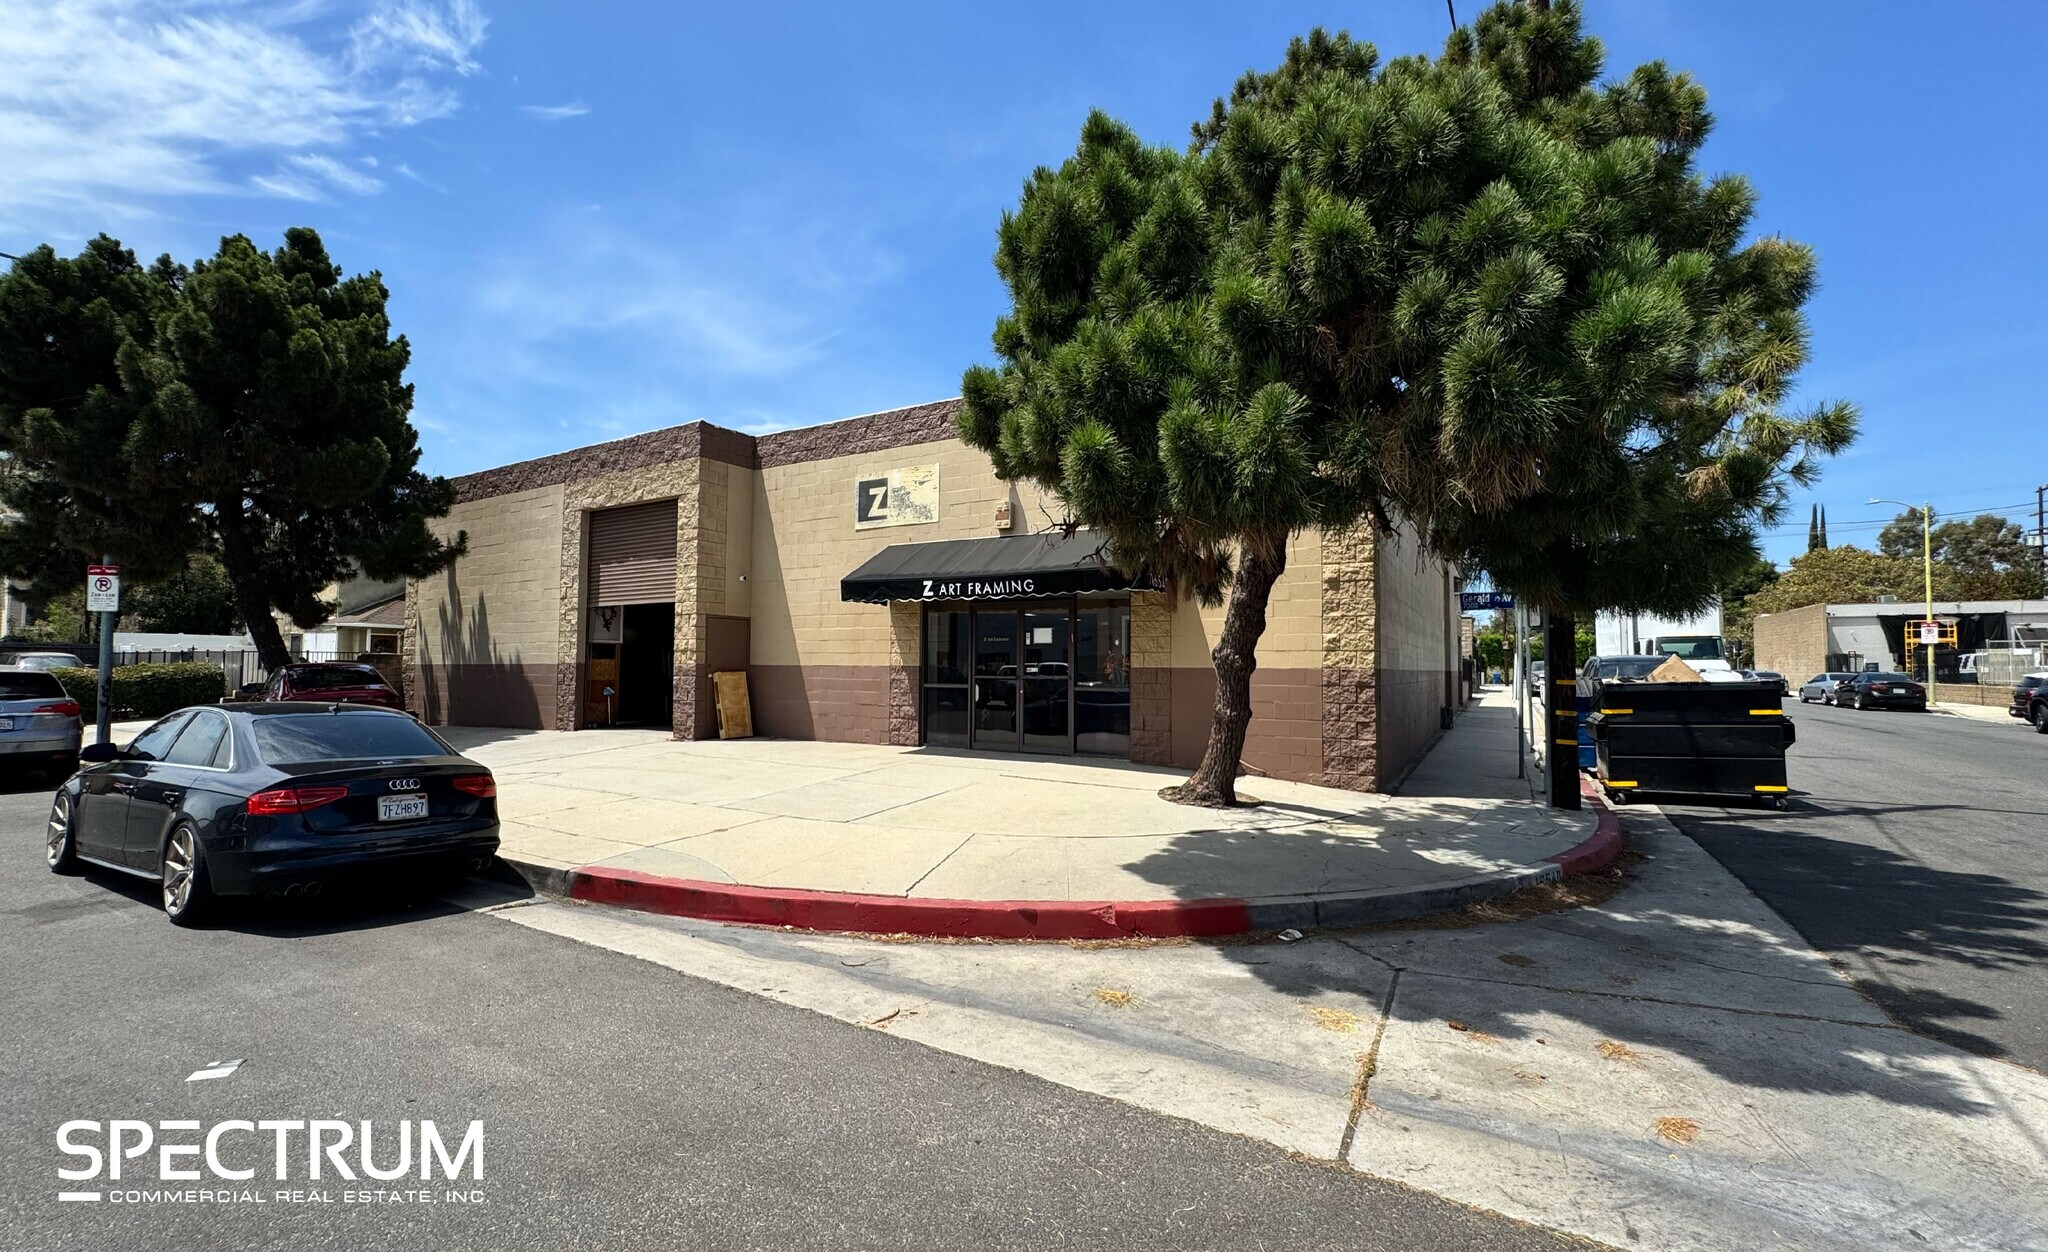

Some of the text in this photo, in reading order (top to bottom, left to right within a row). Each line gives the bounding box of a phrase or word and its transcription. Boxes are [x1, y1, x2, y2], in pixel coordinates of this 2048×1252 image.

[868, 486, 887, 518] Z
[923, 579, 1035, 597] Z ART FRAMING
[1462, 593, 1490, 604] Gerald
[382, 801, 425, 818] 7FZH897
